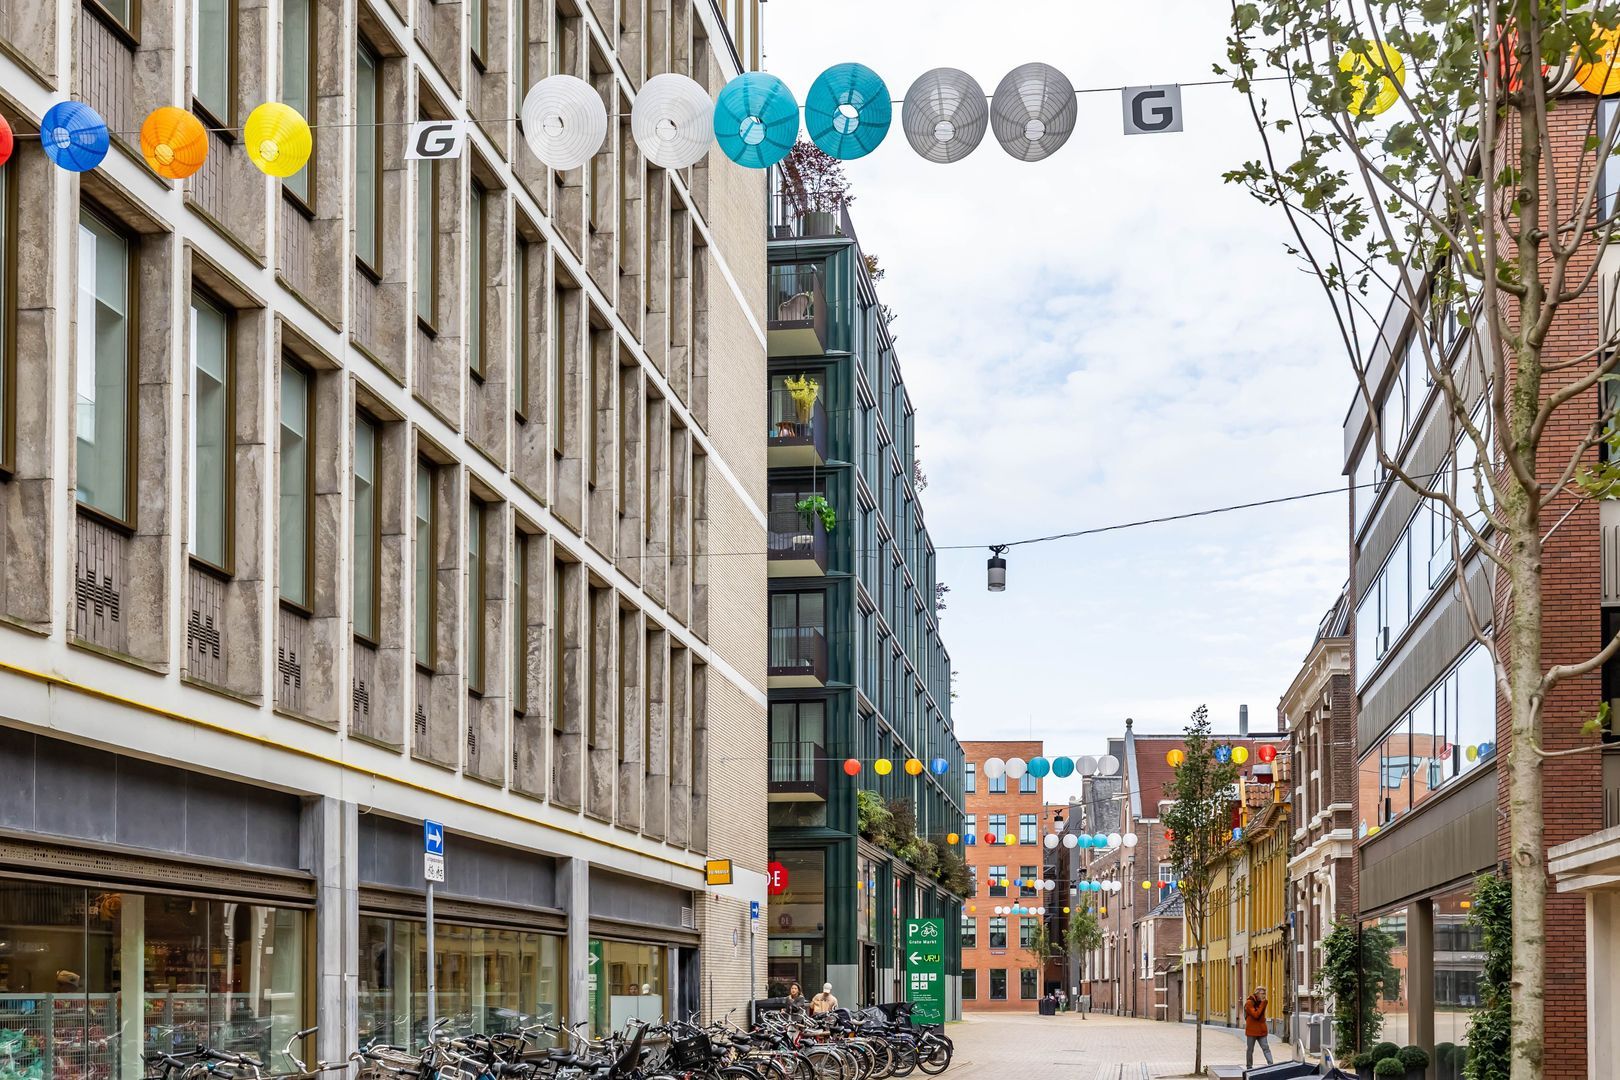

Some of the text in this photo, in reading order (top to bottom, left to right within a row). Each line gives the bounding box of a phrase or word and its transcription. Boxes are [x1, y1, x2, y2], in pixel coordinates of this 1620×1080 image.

[1132, 90, 1173, 131] G
[416, 125, 456, 157] G
[909, 923, 919, 937] P
